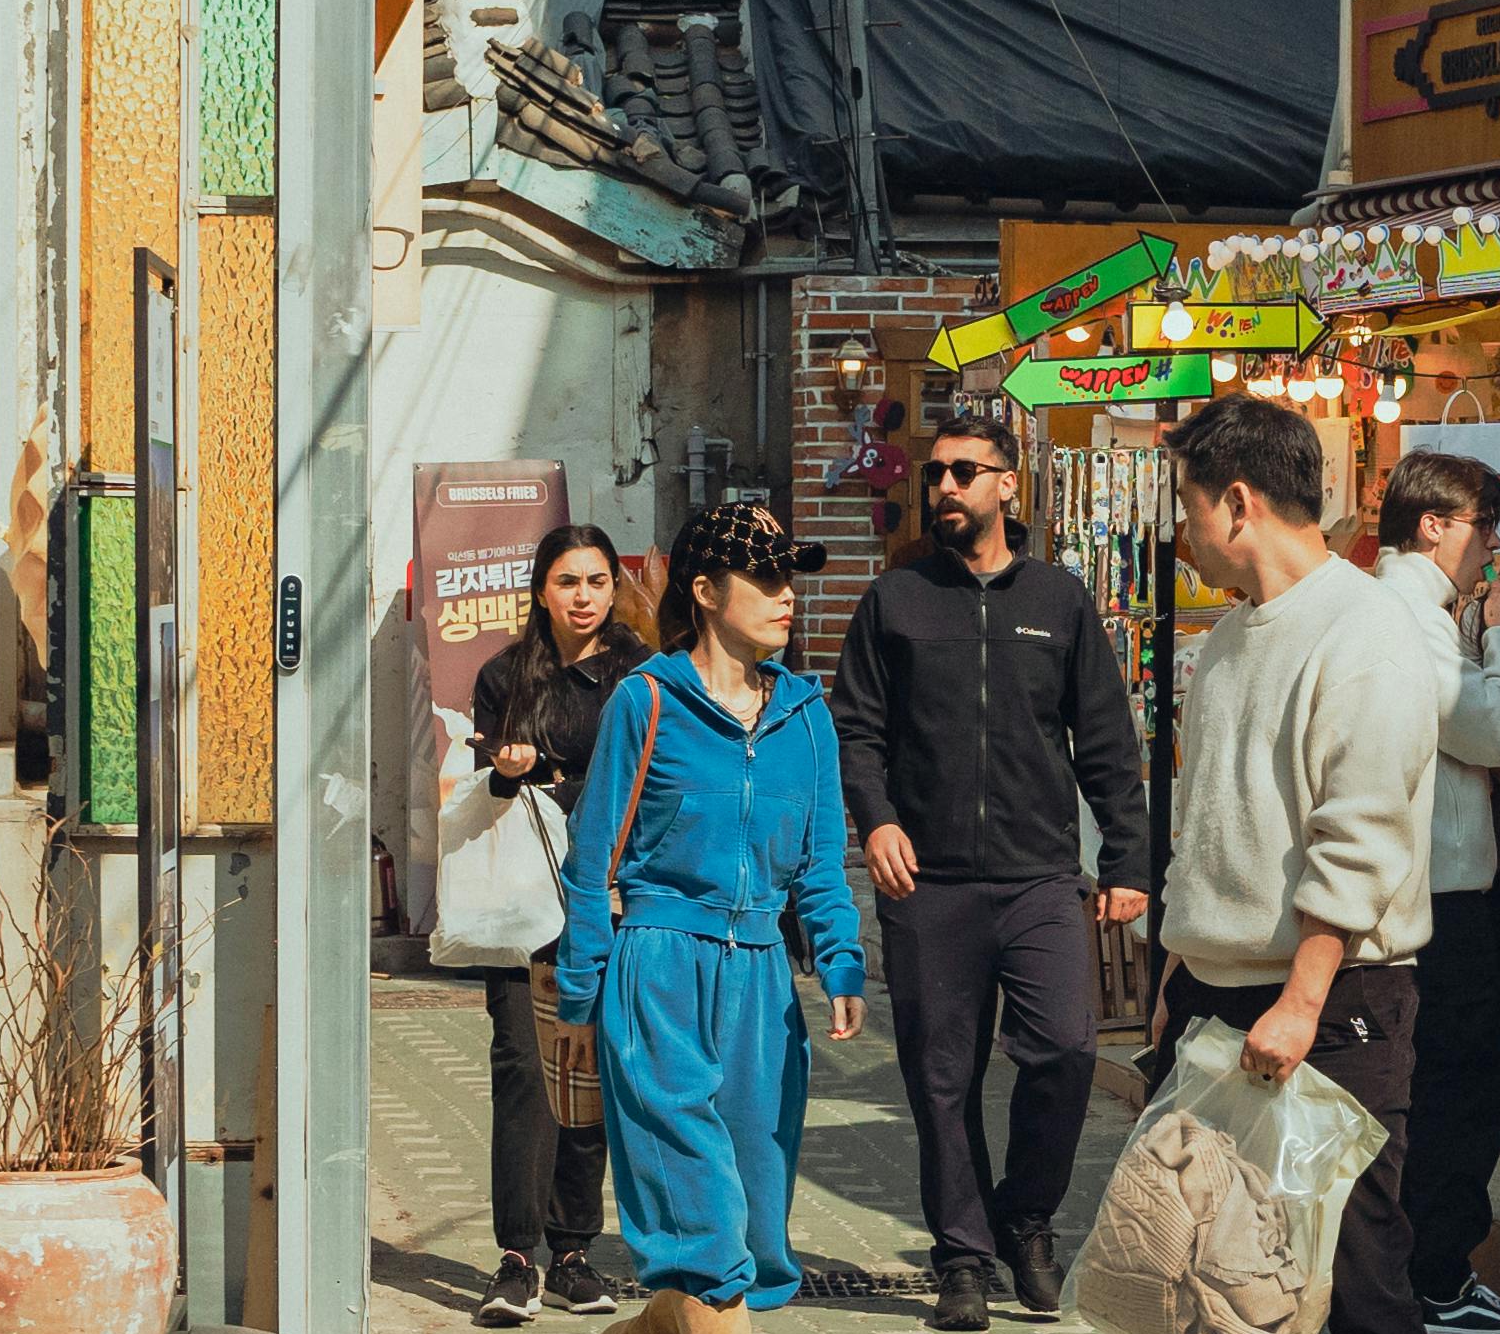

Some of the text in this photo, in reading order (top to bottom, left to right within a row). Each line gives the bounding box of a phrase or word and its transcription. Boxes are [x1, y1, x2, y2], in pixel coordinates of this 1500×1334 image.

[1040, 275, 1098, 313] WAPPEN
[1060, 359, 1150, 393] WAPPEN
[449, 485, 538, 501] BRUSSELS FRIES
